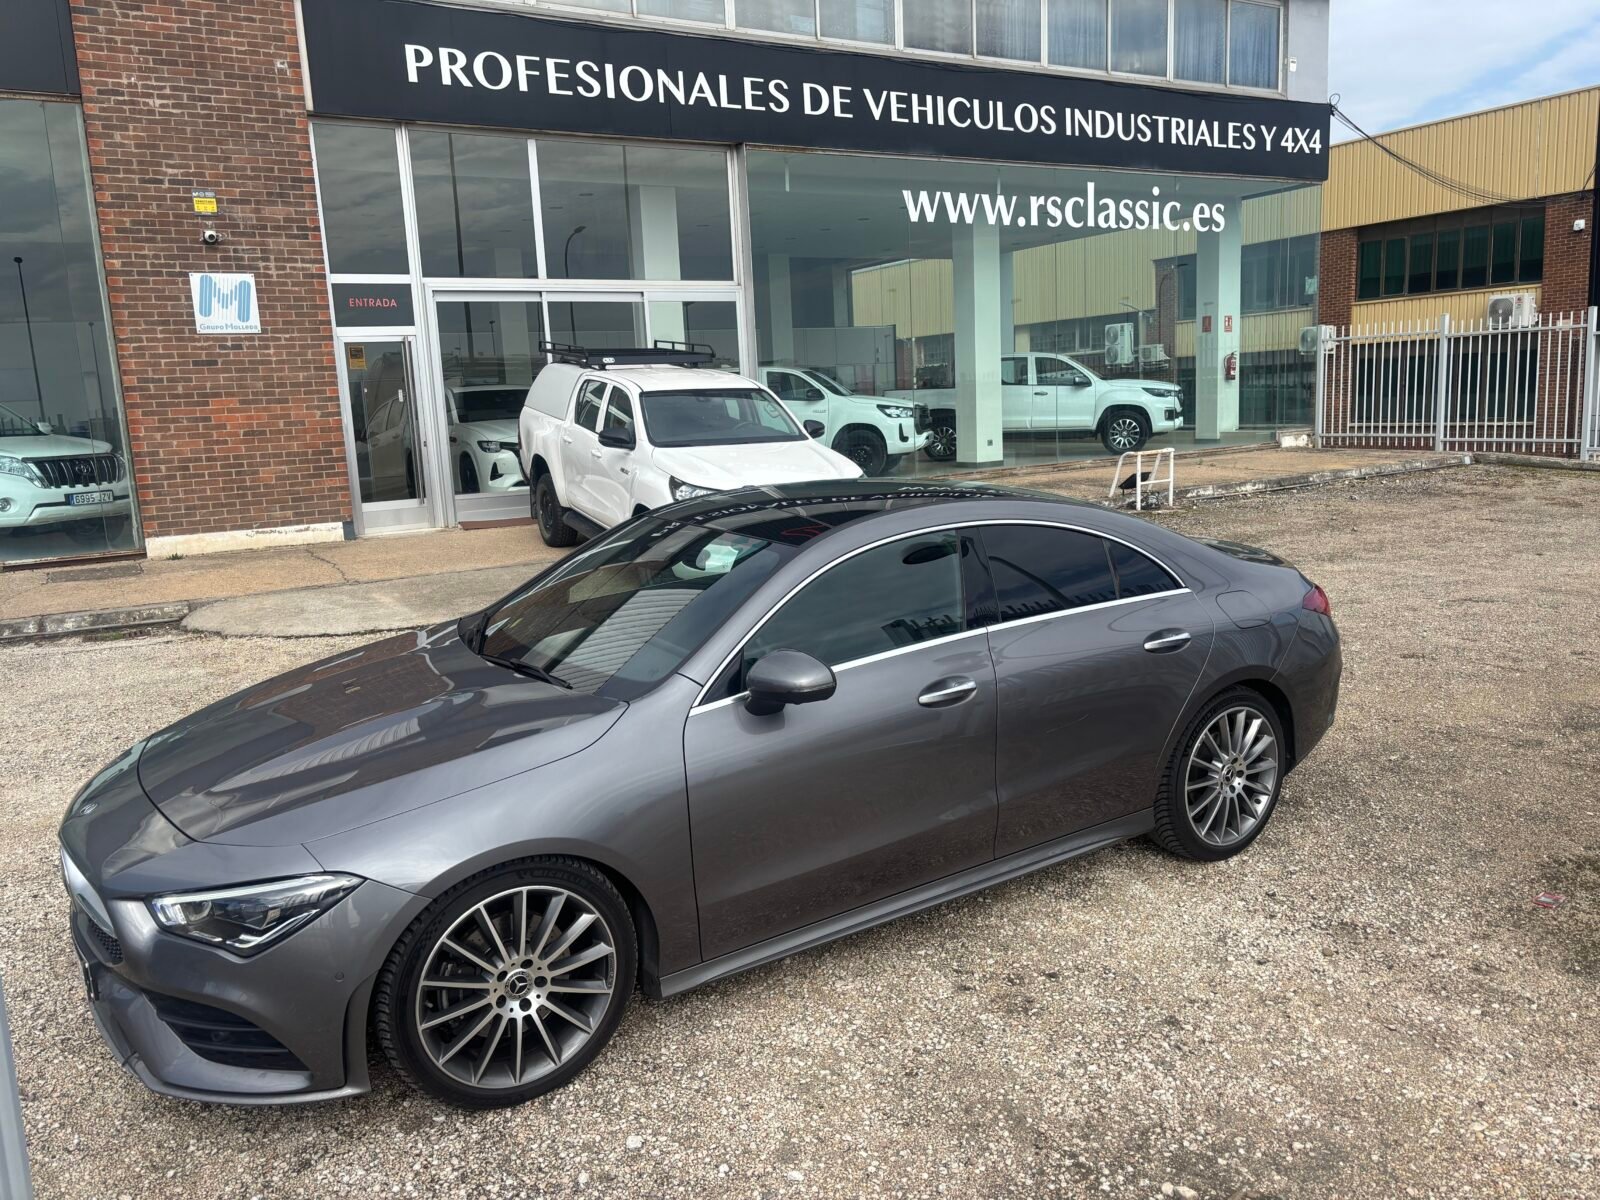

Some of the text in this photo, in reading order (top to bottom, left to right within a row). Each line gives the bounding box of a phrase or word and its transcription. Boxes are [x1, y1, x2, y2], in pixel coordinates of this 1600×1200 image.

[404, 43, 1322, 155] PROFESIONALES DE VEHICULOS INDUSTRIALES Y 4X4
[902, 181, 1226, 233] www.rsclassic.es
[348, 298, 398, 308] ENTRADA
